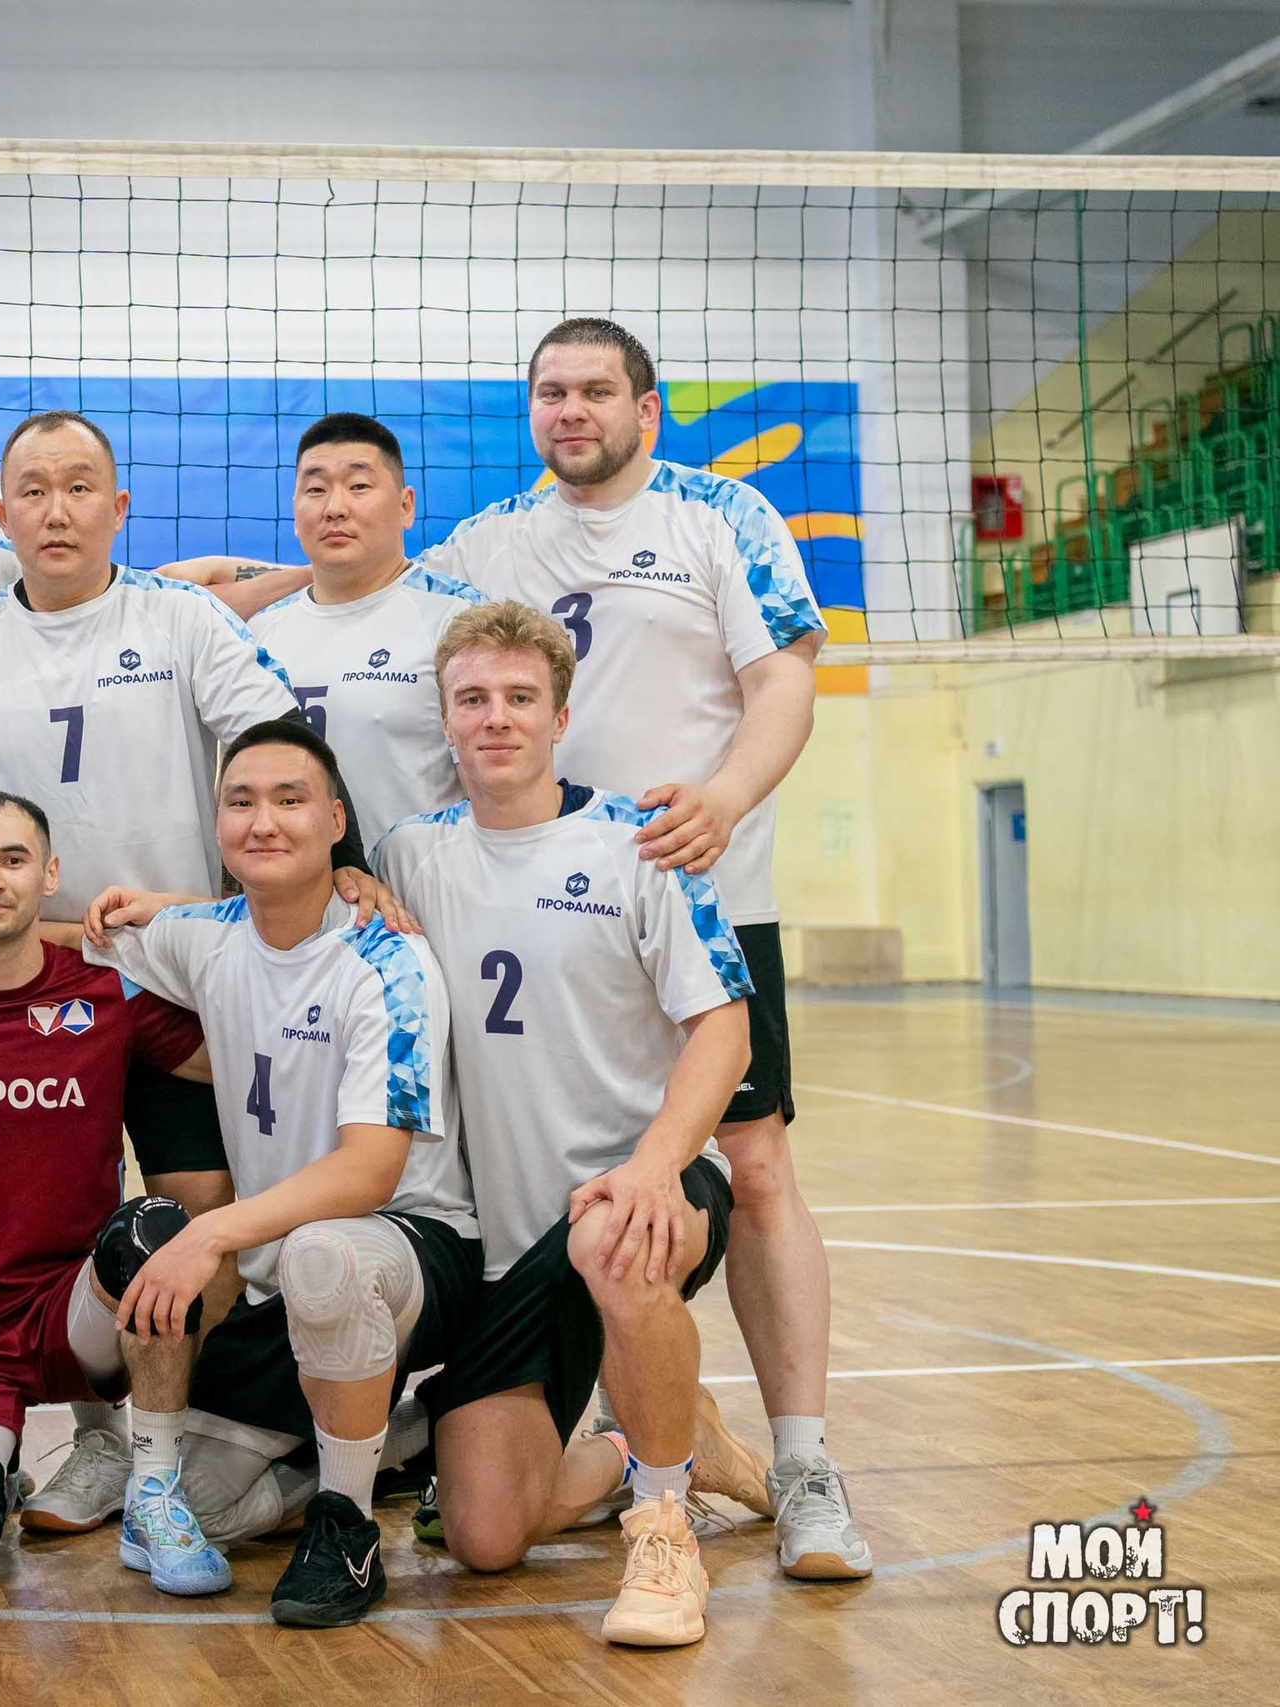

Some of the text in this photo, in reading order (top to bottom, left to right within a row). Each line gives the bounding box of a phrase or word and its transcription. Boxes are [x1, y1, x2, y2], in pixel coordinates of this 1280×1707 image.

[608, 570, 691, 583] ПРОФАЛМАЗ
[551, 592, 593, 662] 3
[97, 670, 173, 688] ПРОФАЛМАЗ
[342, 671, 418, 683] ПРОФАЛМАЗ
[293, 685, 328, 741] 5
[50, 705, 83, 783] 7
[536, 898, 622, 917] ПРОФАЛМАЗ
[481, 950, 523, 1035] 2
[282, 1027, 330, 1043] ПРОФАЛМ
[247, 1052, 276, 1136] 4
